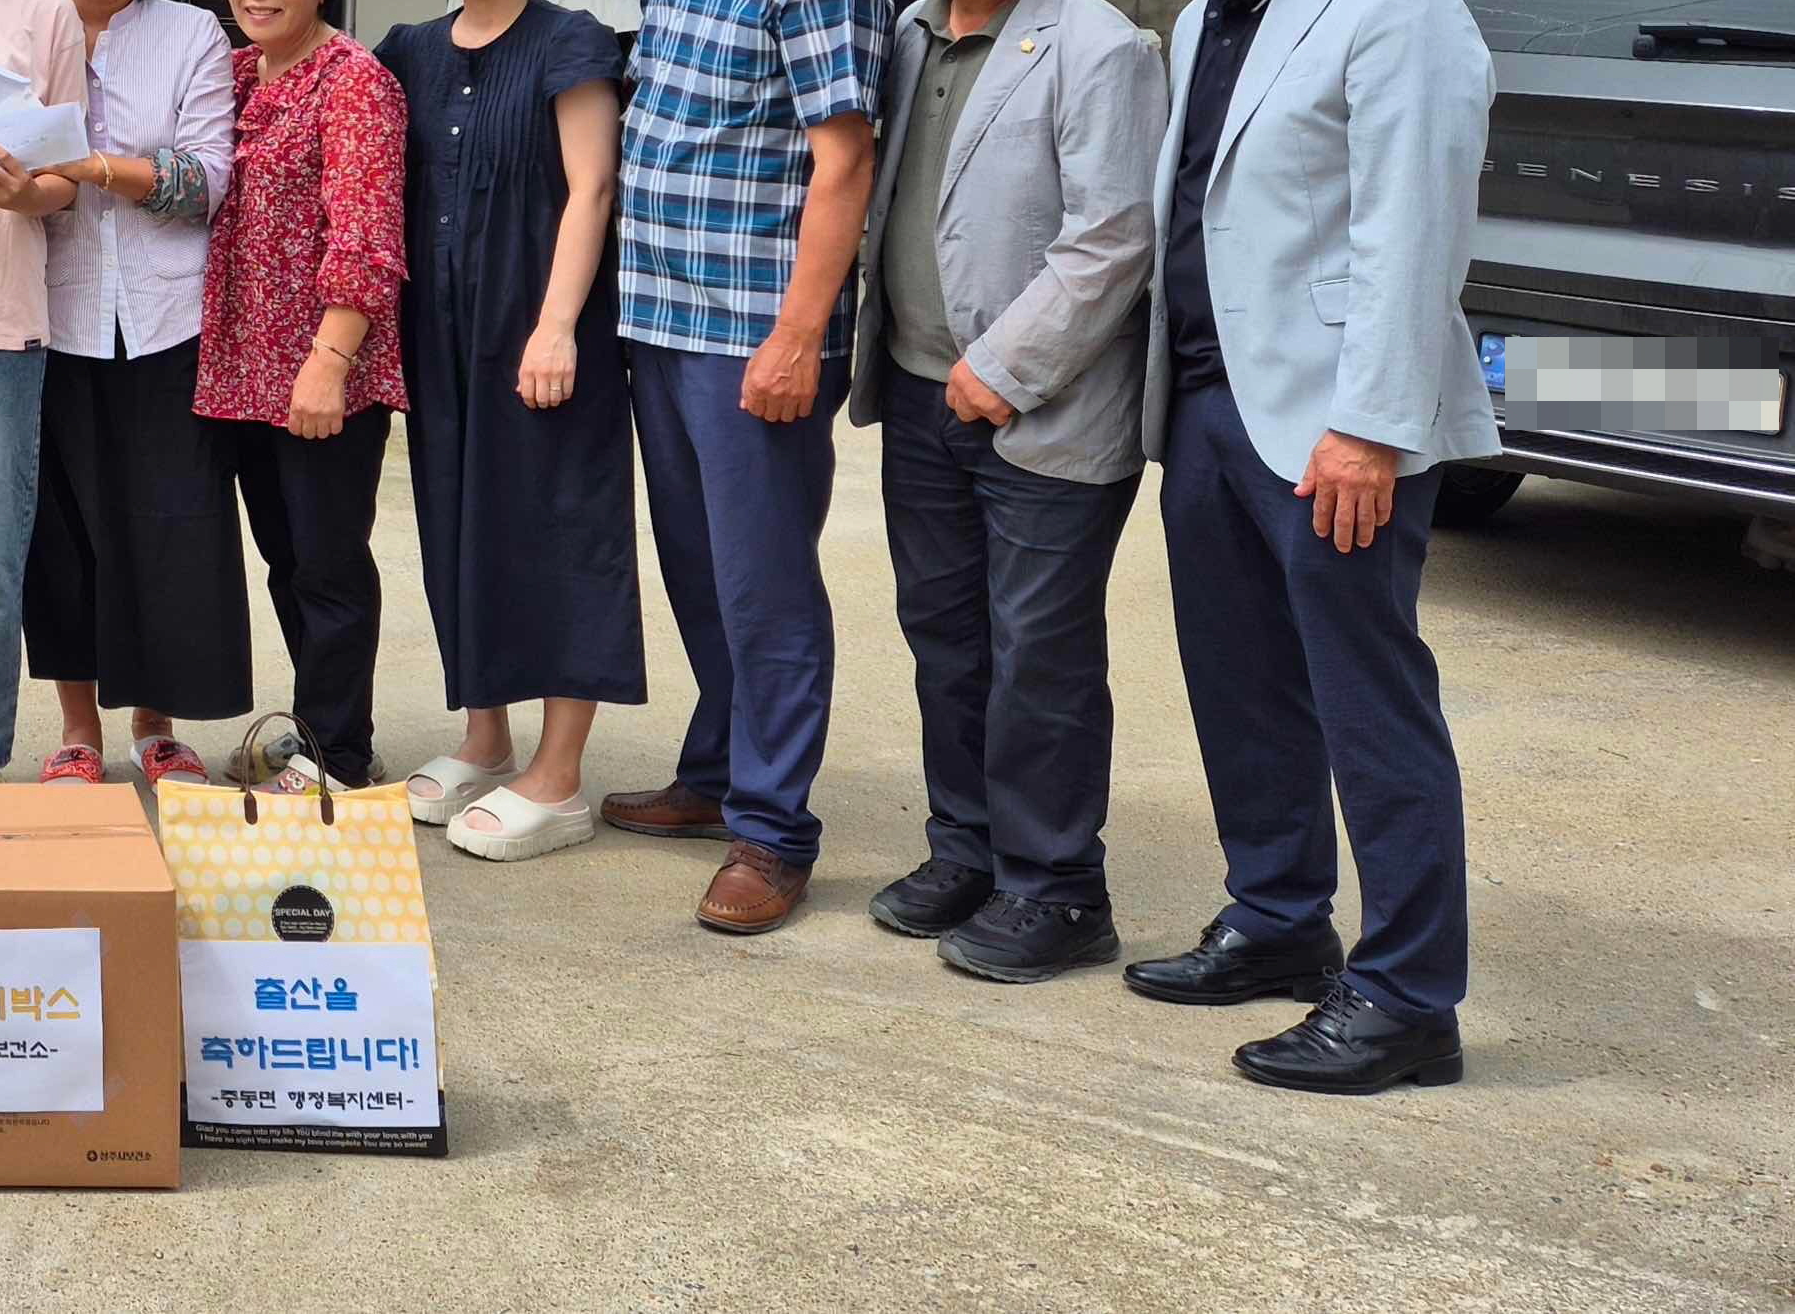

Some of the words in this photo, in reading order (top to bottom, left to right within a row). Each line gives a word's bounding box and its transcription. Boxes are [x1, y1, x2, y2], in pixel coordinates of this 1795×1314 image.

[275, 908, 312, 917] SPECIAL
[313, 909, 330, 918] DAY
[254, 977, 358, 1012] 출산을
[200, 1036, 421, 1071] 축하드립니다!
